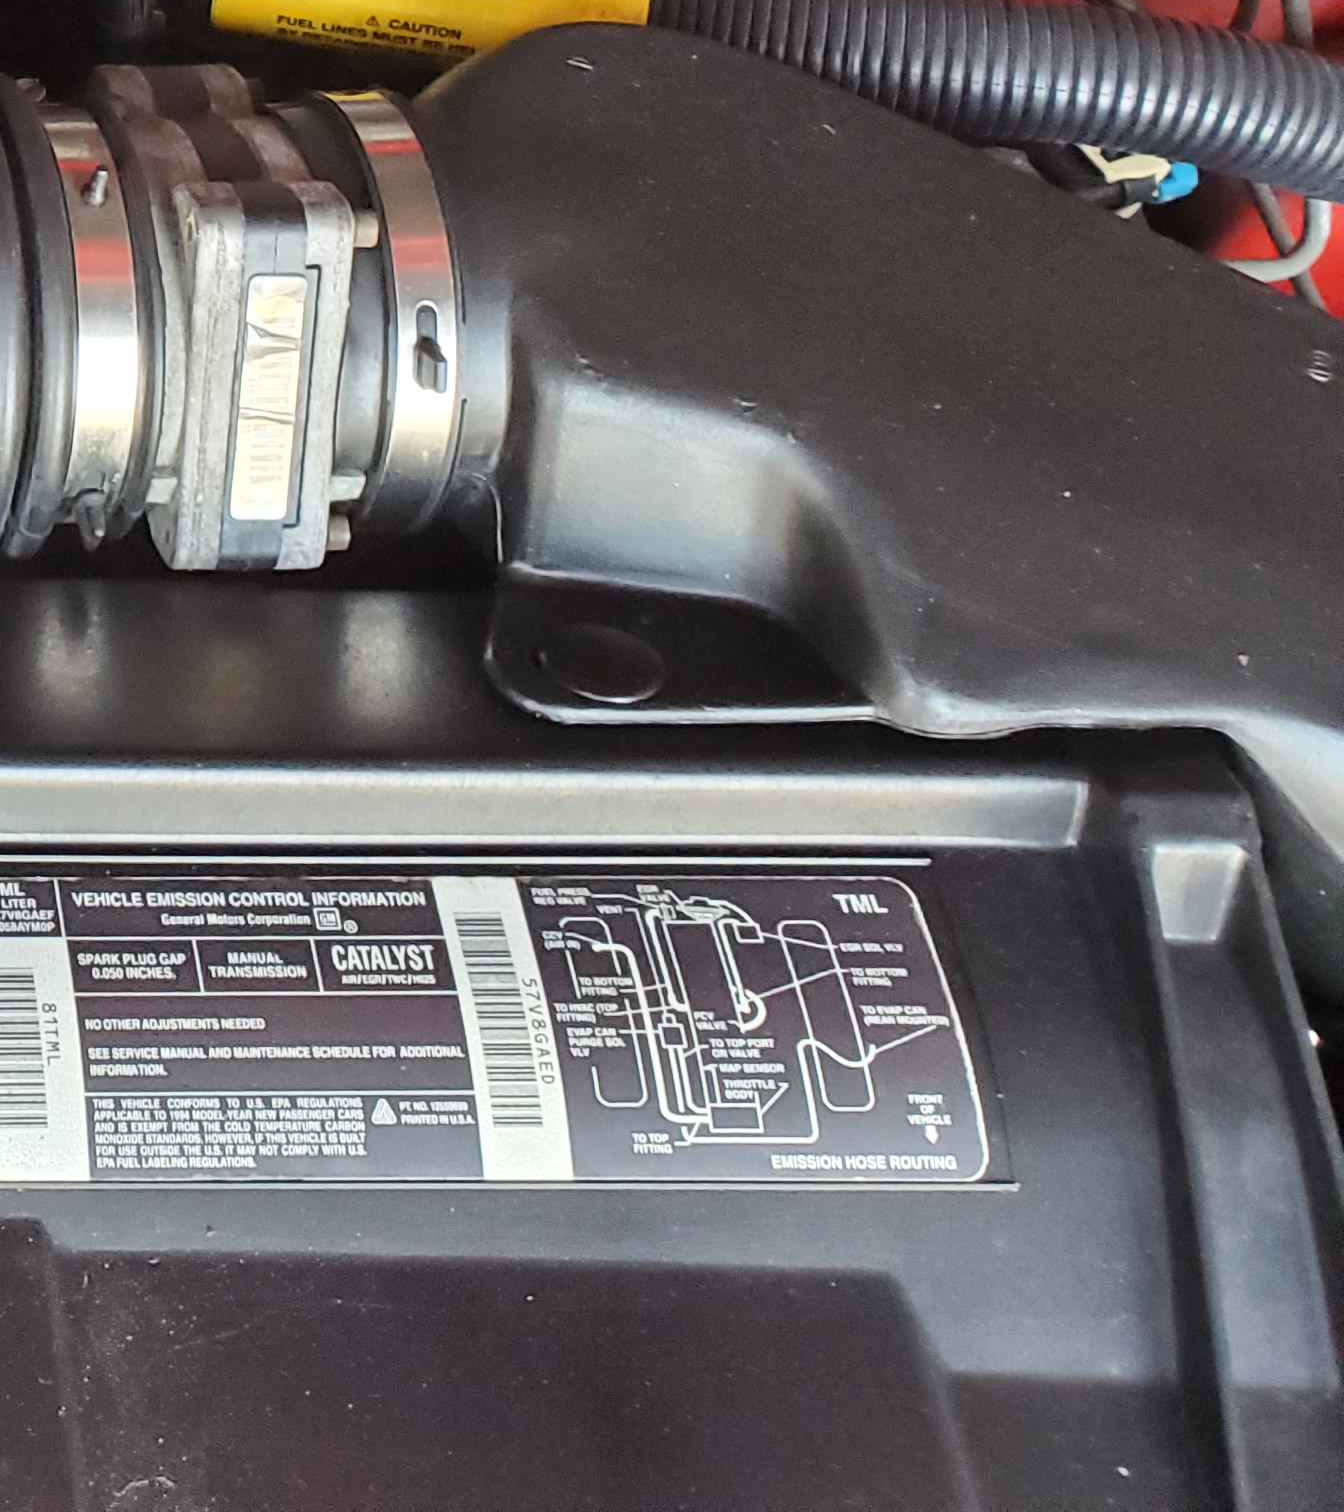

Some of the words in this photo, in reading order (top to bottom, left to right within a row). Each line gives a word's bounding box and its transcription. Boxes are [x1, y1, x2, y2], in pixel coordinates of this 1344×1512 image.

[388, 19, 462, 41] CAUTION
[71, 892, 144, 907] VEHICLE
[146, 892, 226, 907] EMISSION
[228, 892, 310, 907] CONTROL
[311, 891, 426, 907] INFORMATION
[832, 894, 889, 914] TML
[77, 953, 121, 966] SPARK
[122, 953, 157, 965] PLUG
[159, 953, 186, 965] GAP
[227, 952, 284, 964] MANUAL
[331, 944, 434, 971] CATALYST
[92, 967, 124, 980] 0.050
[125, 966, 177, 979] INCHES.
[208, 965, 307, 978] TRANSMISSION
[84, 1018, 102, 1030] NO
[103, 1018, 141, 1030] OTHER
[142, 1018, 220, 1030] ADJUSTMENTS
[220, 1018, 266, 1030] NEEDED
[522, 978, 555, 1084] 57V8GAED
[42, 1003, 61, 1066] 81TML
[771, 1154, 843, 1170] EMISSION
[844, 1155, 887, 1170] HOSE
[889, 1155, 957, 1170] ROUTING
